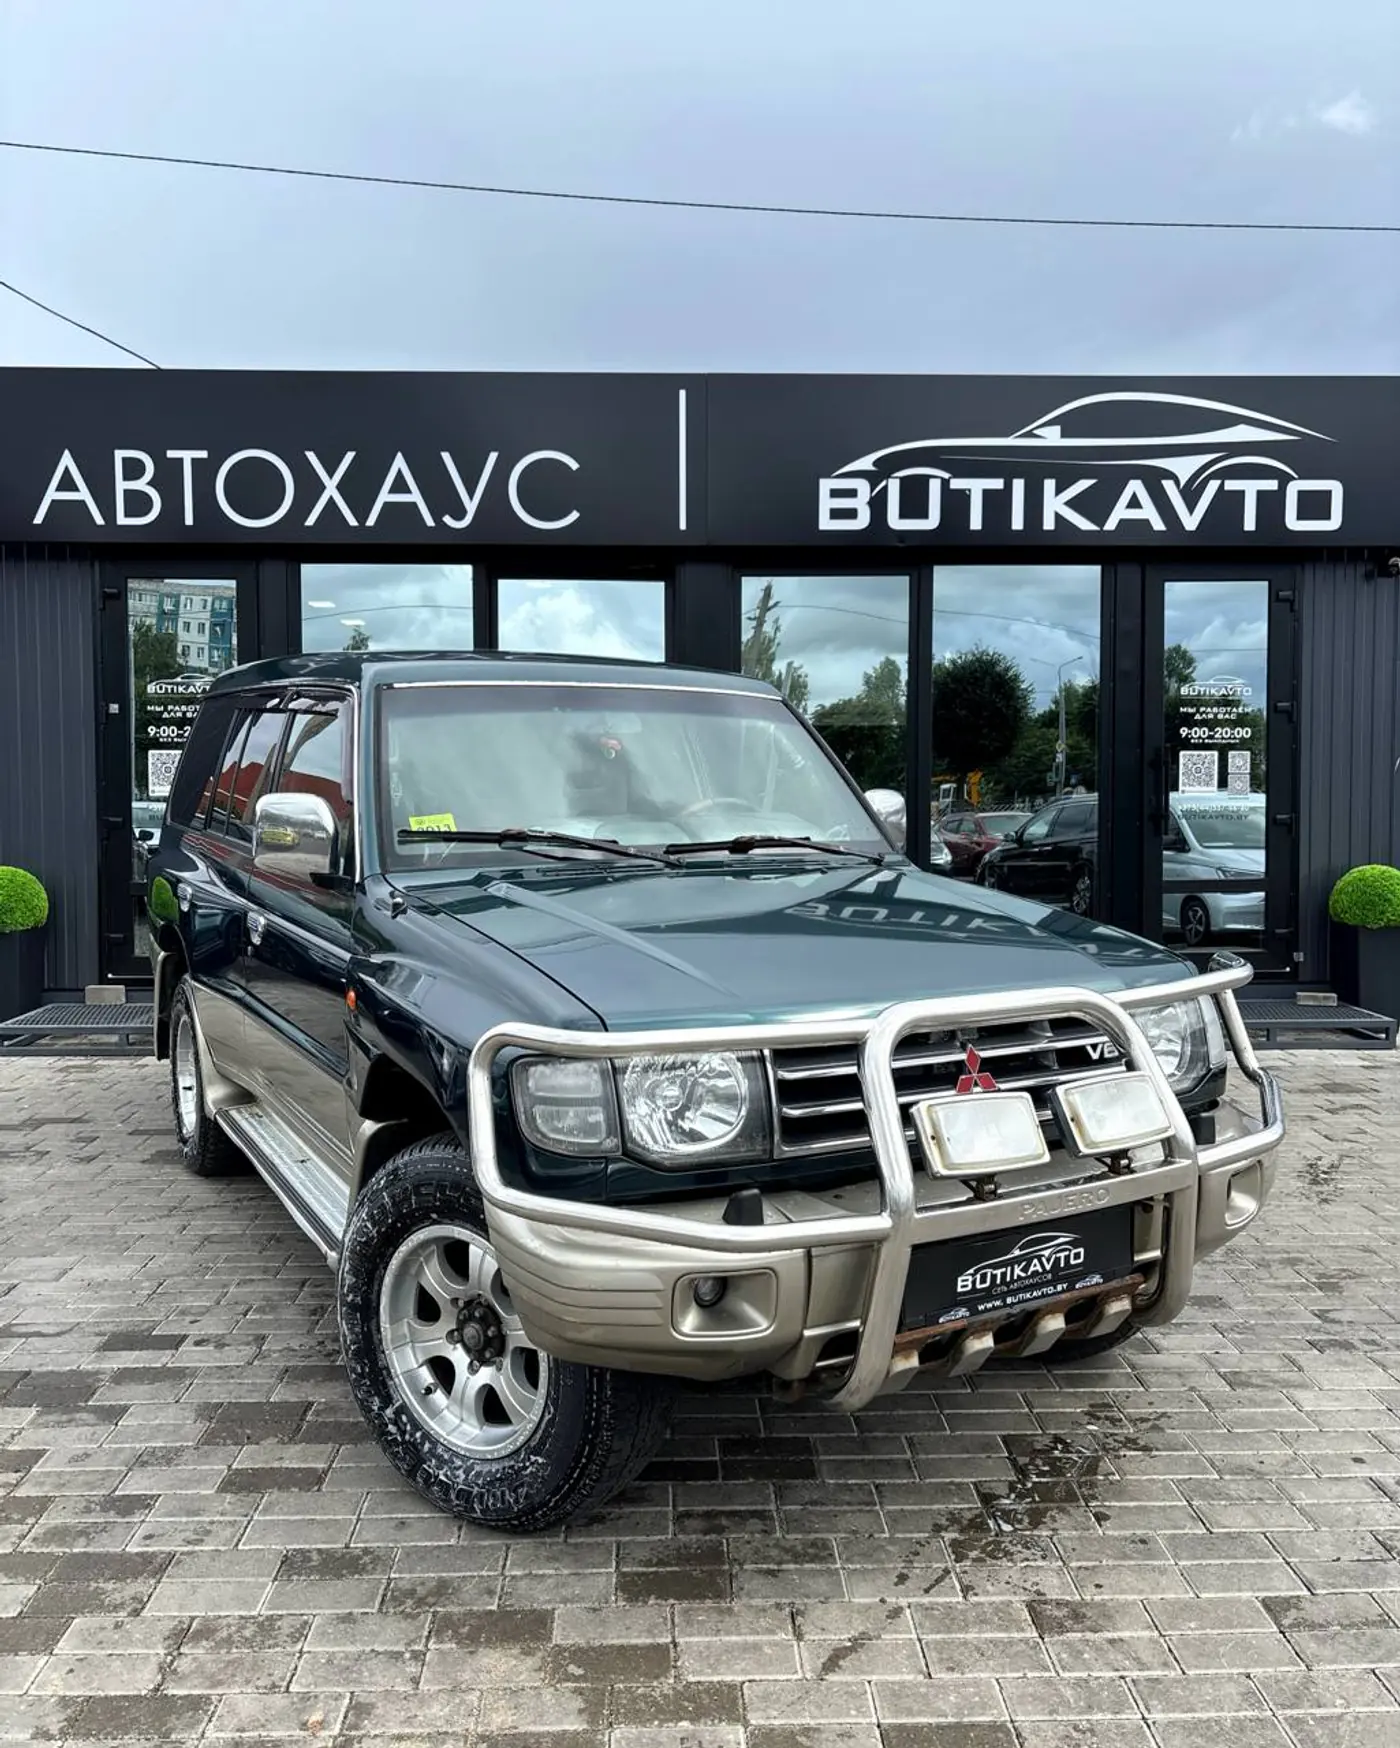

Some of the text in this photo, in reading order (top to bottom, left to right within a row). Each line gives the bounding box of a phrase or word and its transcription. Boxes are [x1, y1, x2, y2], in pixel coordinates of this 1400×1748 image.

[33, 448, 581, 530] АВТОХАУС
[819, 477, 1344, 532] BUTIKAVTO
[147, 684, 211, 694] BUTIKAVT
[1180, 686, 1253, 696] BUTIKAVTO
[167, 704, 200, 712] РАБОТ
[147, 725, 192, 738] 9:00-2
[1180, 727, 1252, 738] 9:00-20:00
[1019, 1187, 1111, 1221] PAJERO
[956, 1247, 1085, 1293] BUTIKAVTO
[992, 1285, 1008, 1295] СЕТЬ
[1006, 1282, 1069, 1304] BUTIKAVTO.BY
